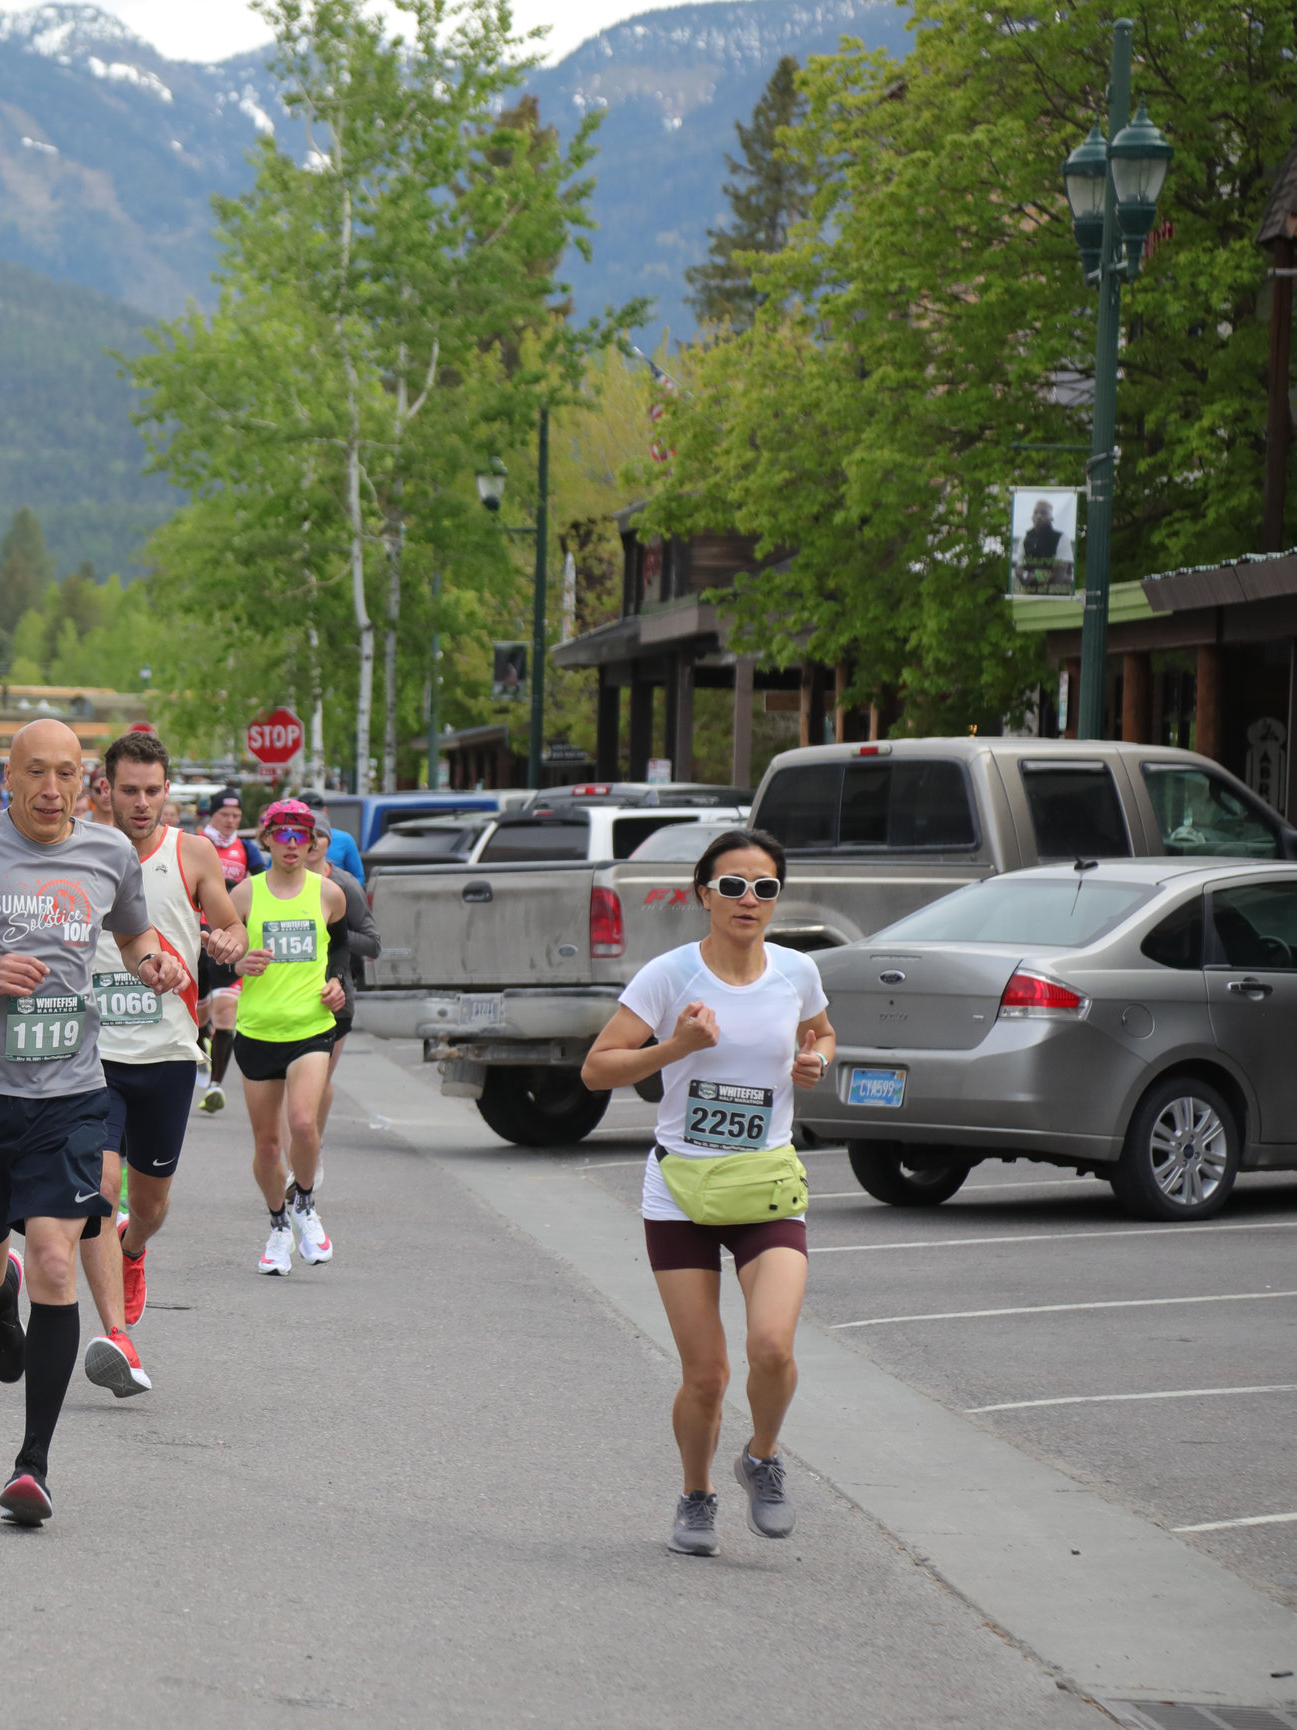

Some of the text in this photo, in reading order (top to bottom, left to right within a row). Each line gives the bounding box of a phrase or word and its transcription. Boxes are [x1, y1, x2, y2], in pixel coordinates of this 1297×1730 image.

[250, 725, 300, 749] STOP
[3, 903, 82, 943] Solstice
[63, 922, 93, 942] 10K
[267, 936, 313, 955] 1154
[36, 996, 78, 1008] WHITEFISH
[97, 992, 157, 1016] 1066
[13, 1020, 79, 1049] 1119
[719, 1085, 765, 1101] WHITEFISH
[690, 1107, 765, 1140] 2256
